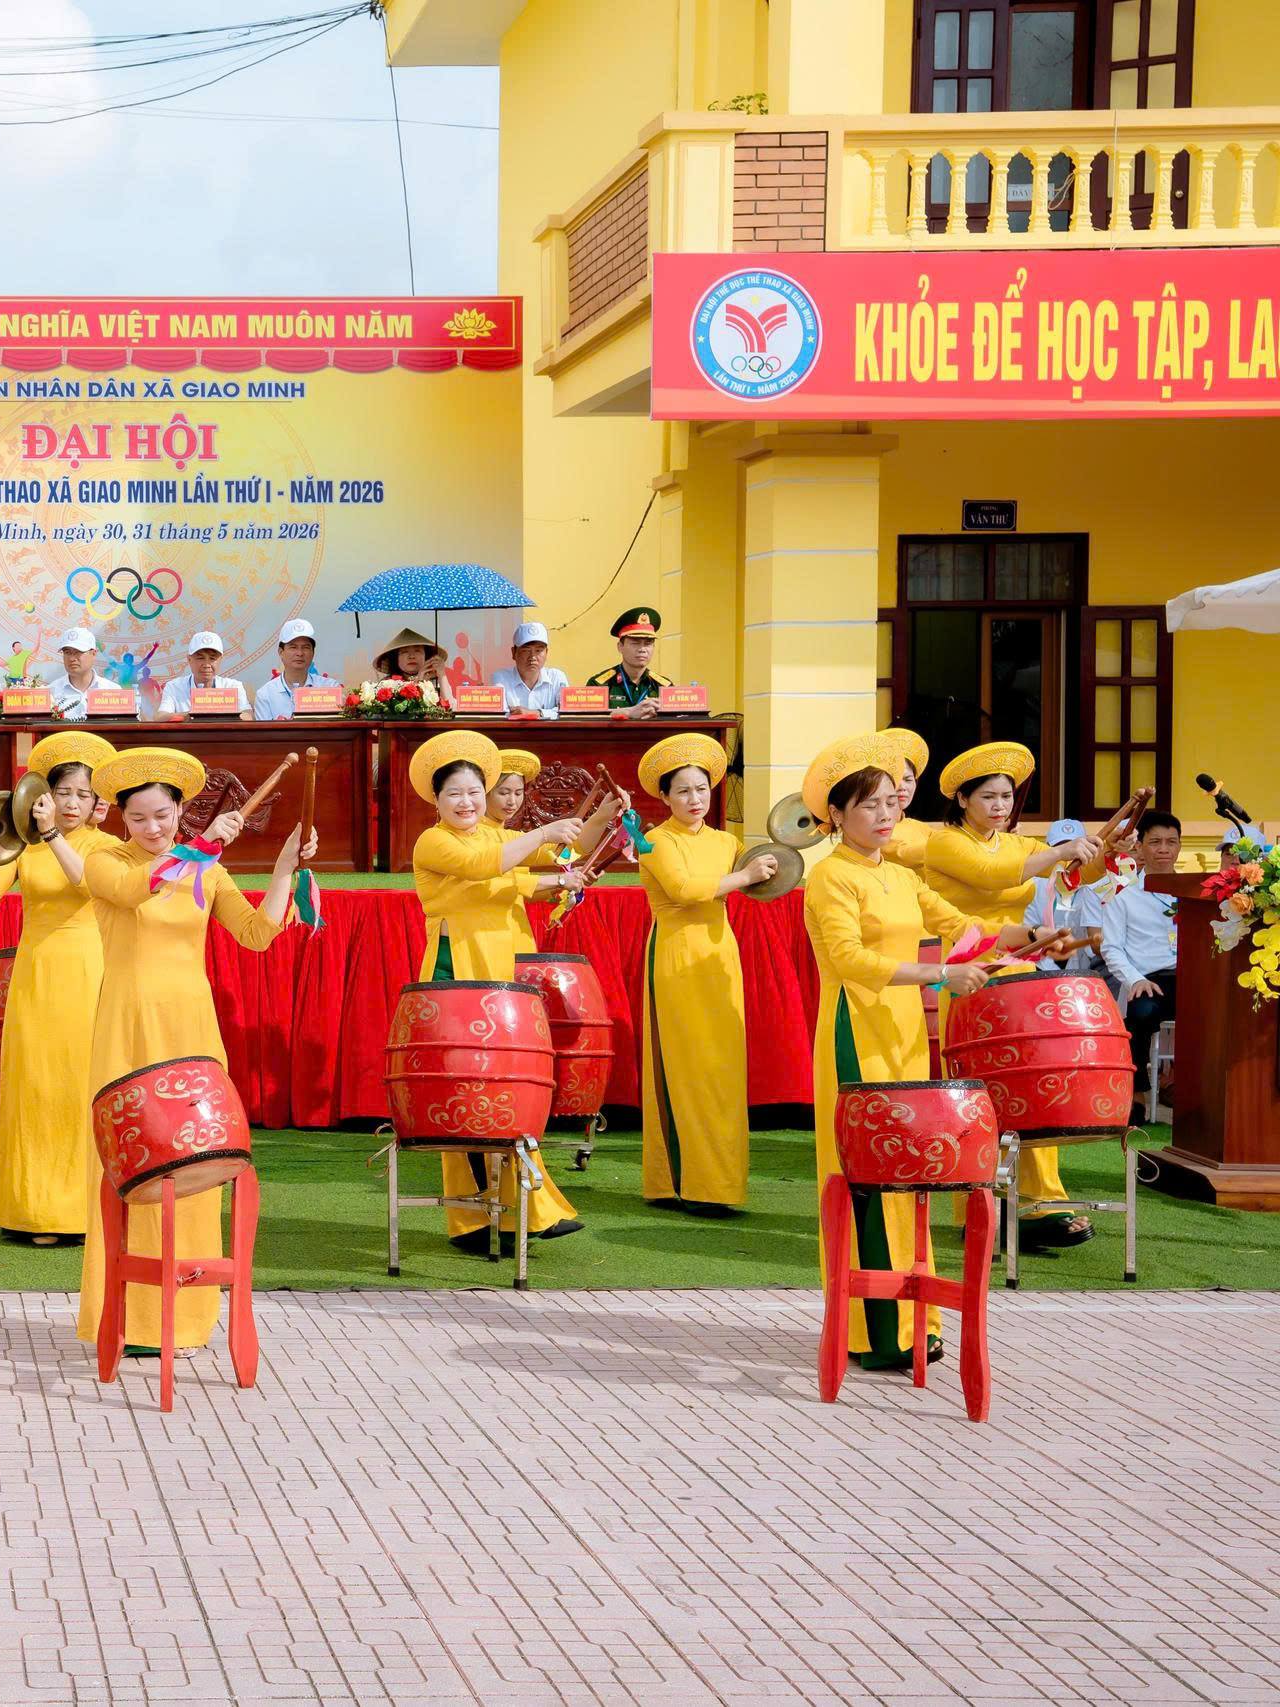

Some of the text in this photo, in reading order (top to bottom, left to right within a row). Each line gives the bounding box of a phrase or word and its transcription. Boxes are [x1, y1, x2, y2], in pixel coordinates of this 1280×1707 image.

[0, 310, 89, 338] NGHĨA
[99, 309, 160, 342] VIỆT
[169, 314, 238, 338] NAM
[247, 311, 336, 339] MUÔN
[345, 311, 413, 338] NĂM
[854, 267, 1280, 400] KHỎE ĐỂ HỌC TẬP, LA
[16, 377, 80, 398] NHÂN
[88, 377, 135, 398] DÂN
[143, 378, 175, 398] XÃ
[181, 382, 240, 398] GIAO
[248, 382, 305, 398] MINH
[21, 412, 219, 470] ĐẠI HỘI
[47, 476, 72, 503] XÃ
[78, 480, 121, 504] GIAO
[127, 480, 177, 504] MINH
[183, 473, 219, 504] LẦN
[224, 476, 262, 504] THỨ
[265, 480, 272, 504] I
[290, 475, 334, 504] NĂM
[339, 480, 384, 504] 2026
[53, 523, 97, 544] ngày
[103, 523, 128, 543] 30,
[132, 523, 152, 540] 31
[159, 523, 214, 544] tháng
[217, 523, 229, 540] 5
[233, 523, 273, 540] năm
[277, 523, 320, 540] 2026
